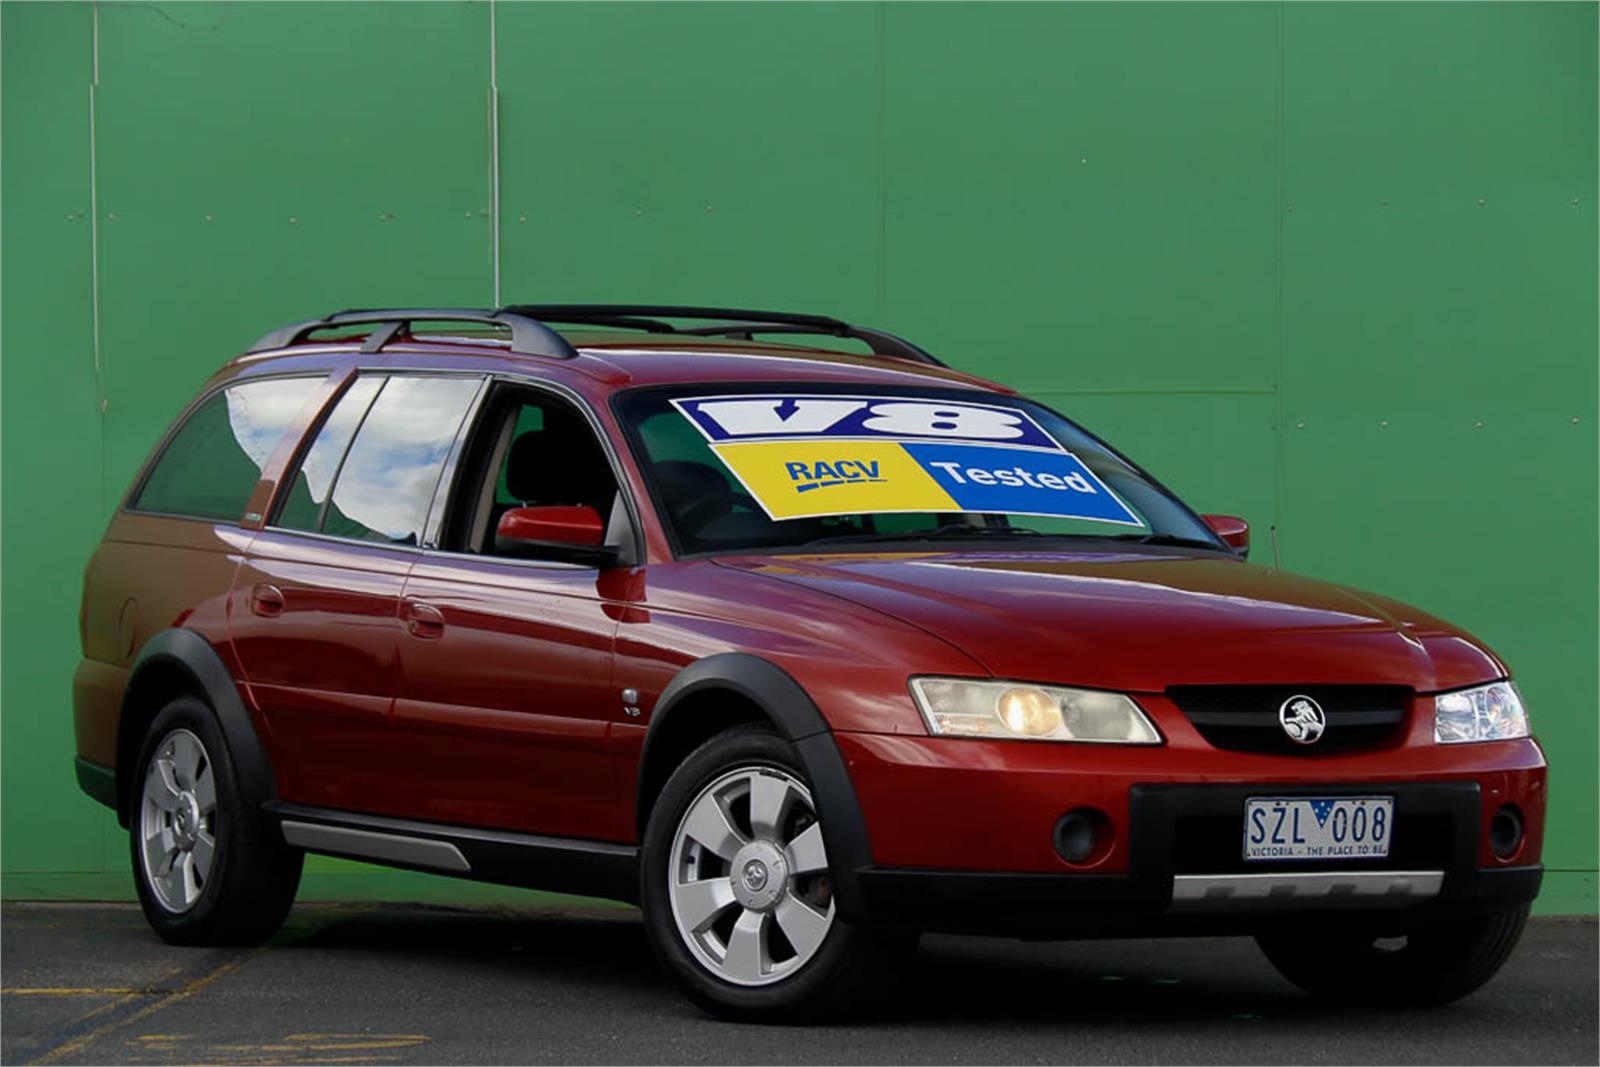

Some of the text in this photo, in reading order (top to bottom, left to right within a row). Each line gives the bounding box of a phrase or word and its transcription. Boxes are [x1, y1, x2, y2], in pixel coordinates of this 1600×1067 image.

[697, 399, 1024, 439] V8
[784, 460, 1098, 494] RACV Tested
[1251, 807, 1386, 844] SZL 008
[1252, 847, 1294, 857] VICTORIA
[1307, 847, 1324, 855] THE
[1328, 846, 1354, 855] PLACE
[1358, 845, 1369, 855] TO
